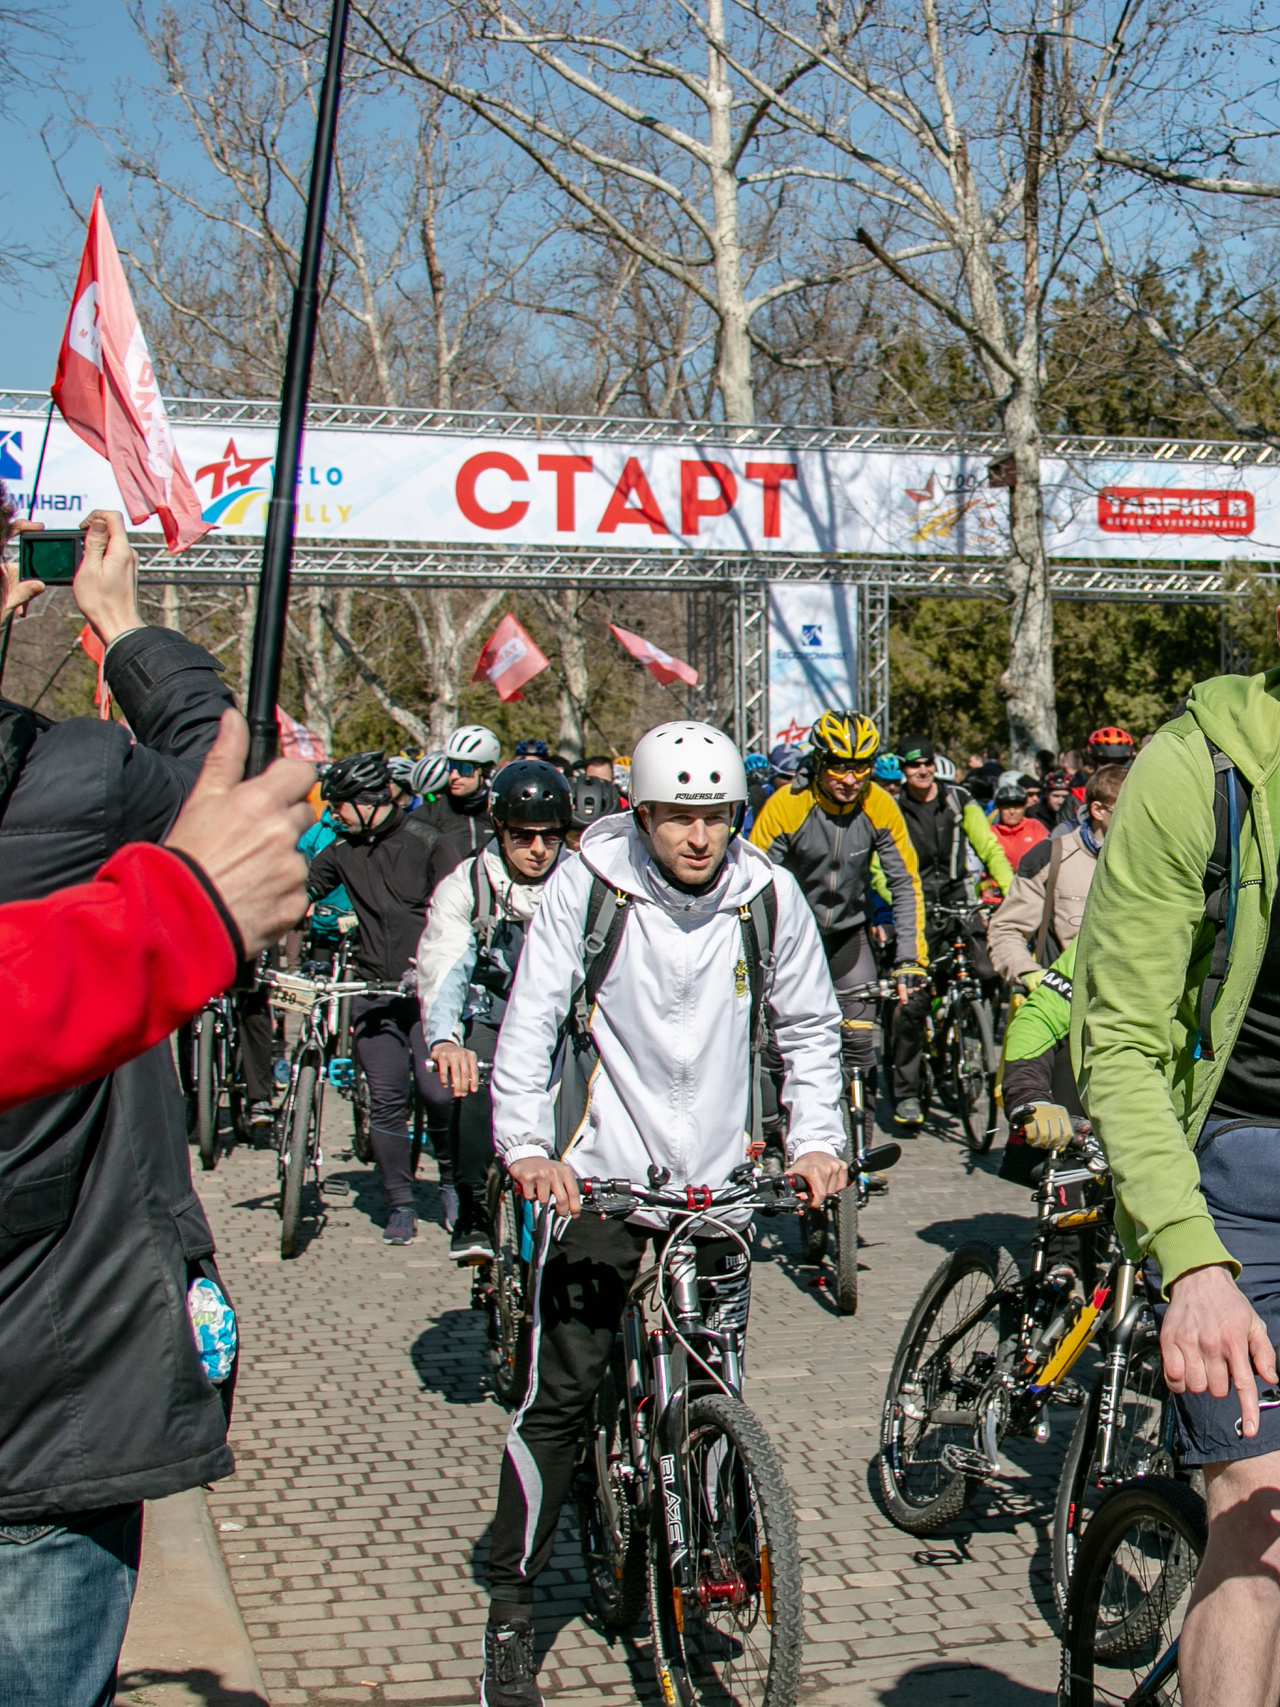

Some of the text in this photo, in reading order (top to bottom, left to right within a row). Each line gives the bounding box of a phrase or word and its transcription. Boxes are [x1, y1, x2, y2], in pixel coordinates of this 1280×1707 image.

[269, 464, 344, 486] ELO
[455, 450, 798, 539] СТАРТ
[262, 503, 353, 525] LLY
[1106, 495, 1220, 517] ТАВРИЯ
[674, 792, 728, 801] POWERSLIDE
